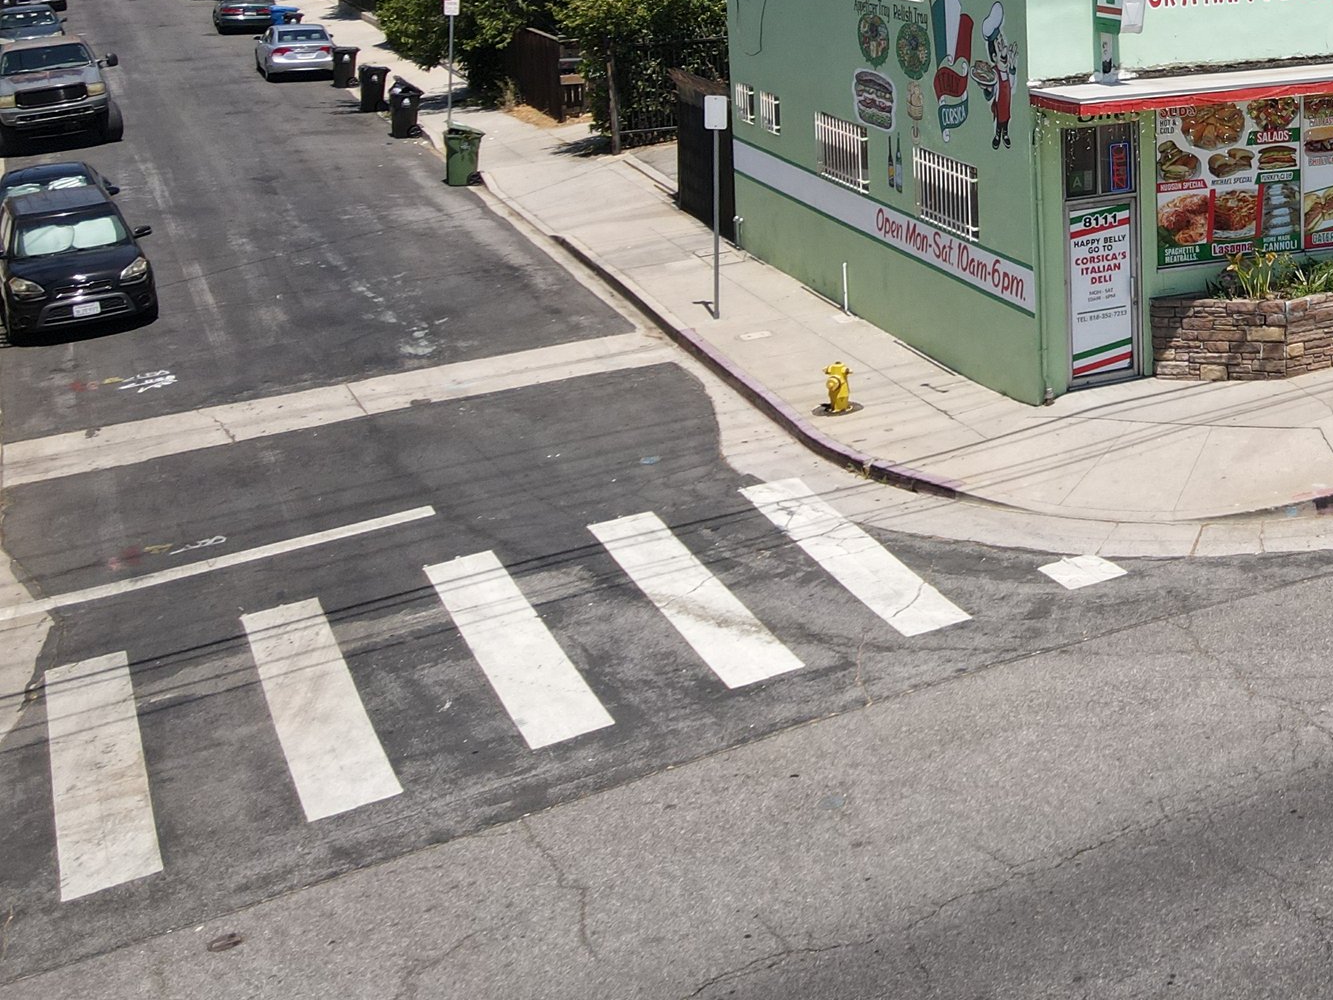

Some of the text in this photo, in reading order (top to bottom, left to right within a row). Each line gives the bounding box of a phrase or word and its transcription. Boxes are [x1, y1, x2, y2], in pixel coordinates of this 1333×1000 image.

[941, 105, 966, 126] CORSICA
[1257, 131, 1289, 143] SALADS
[1182, 180, 1204, 189] SPECIAL
[876, 207, 903, 241] Open
[1083, 213, 1117, 228] 8111
[1073, 234, 1126, 248] HAPPY BELLY
[1263, 240, 1297, 252] CANNOLI
[1088, 244, 1113, 254] GO TO
[1164, 246, 1195, 255] SPAGHETTI
[1212, 242, 1253, 256] Lasagna
[1075, 251, 1127, 266] CORSICA'S
[1081, 263, 1121, 276] ITALIAN
[1090, 274, 1112, 285] DELI
